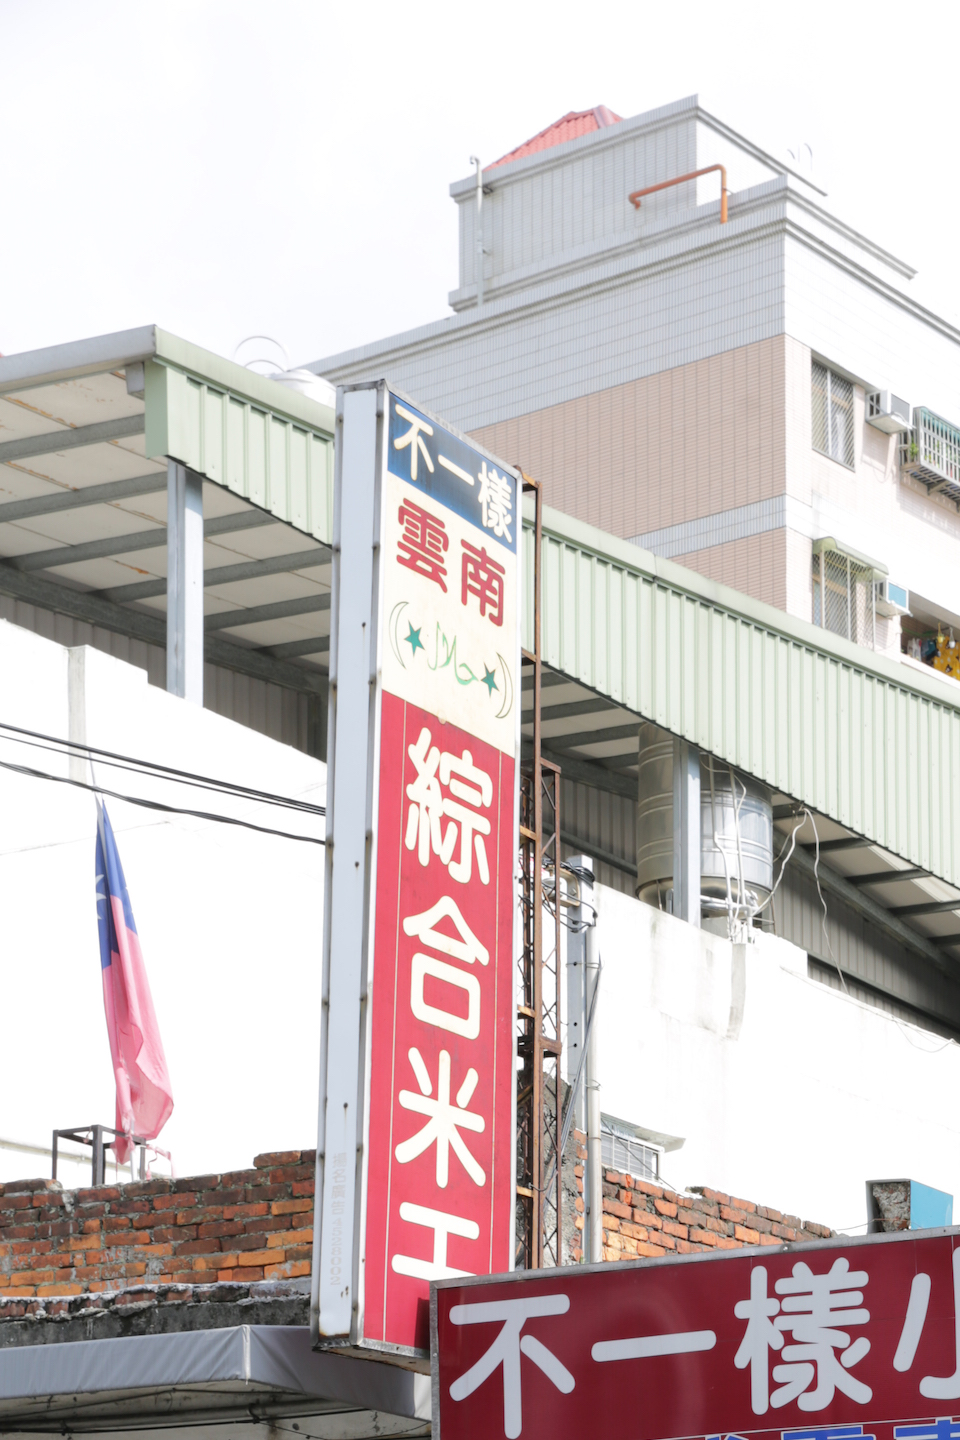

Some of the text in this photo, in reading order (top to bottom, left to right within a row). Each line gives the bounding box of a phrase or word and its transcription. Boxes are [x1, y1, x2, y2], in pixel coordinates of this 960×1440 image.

[394, 402, 513, 544] 不一樣
[396, 498, 506, 627] 雲南
